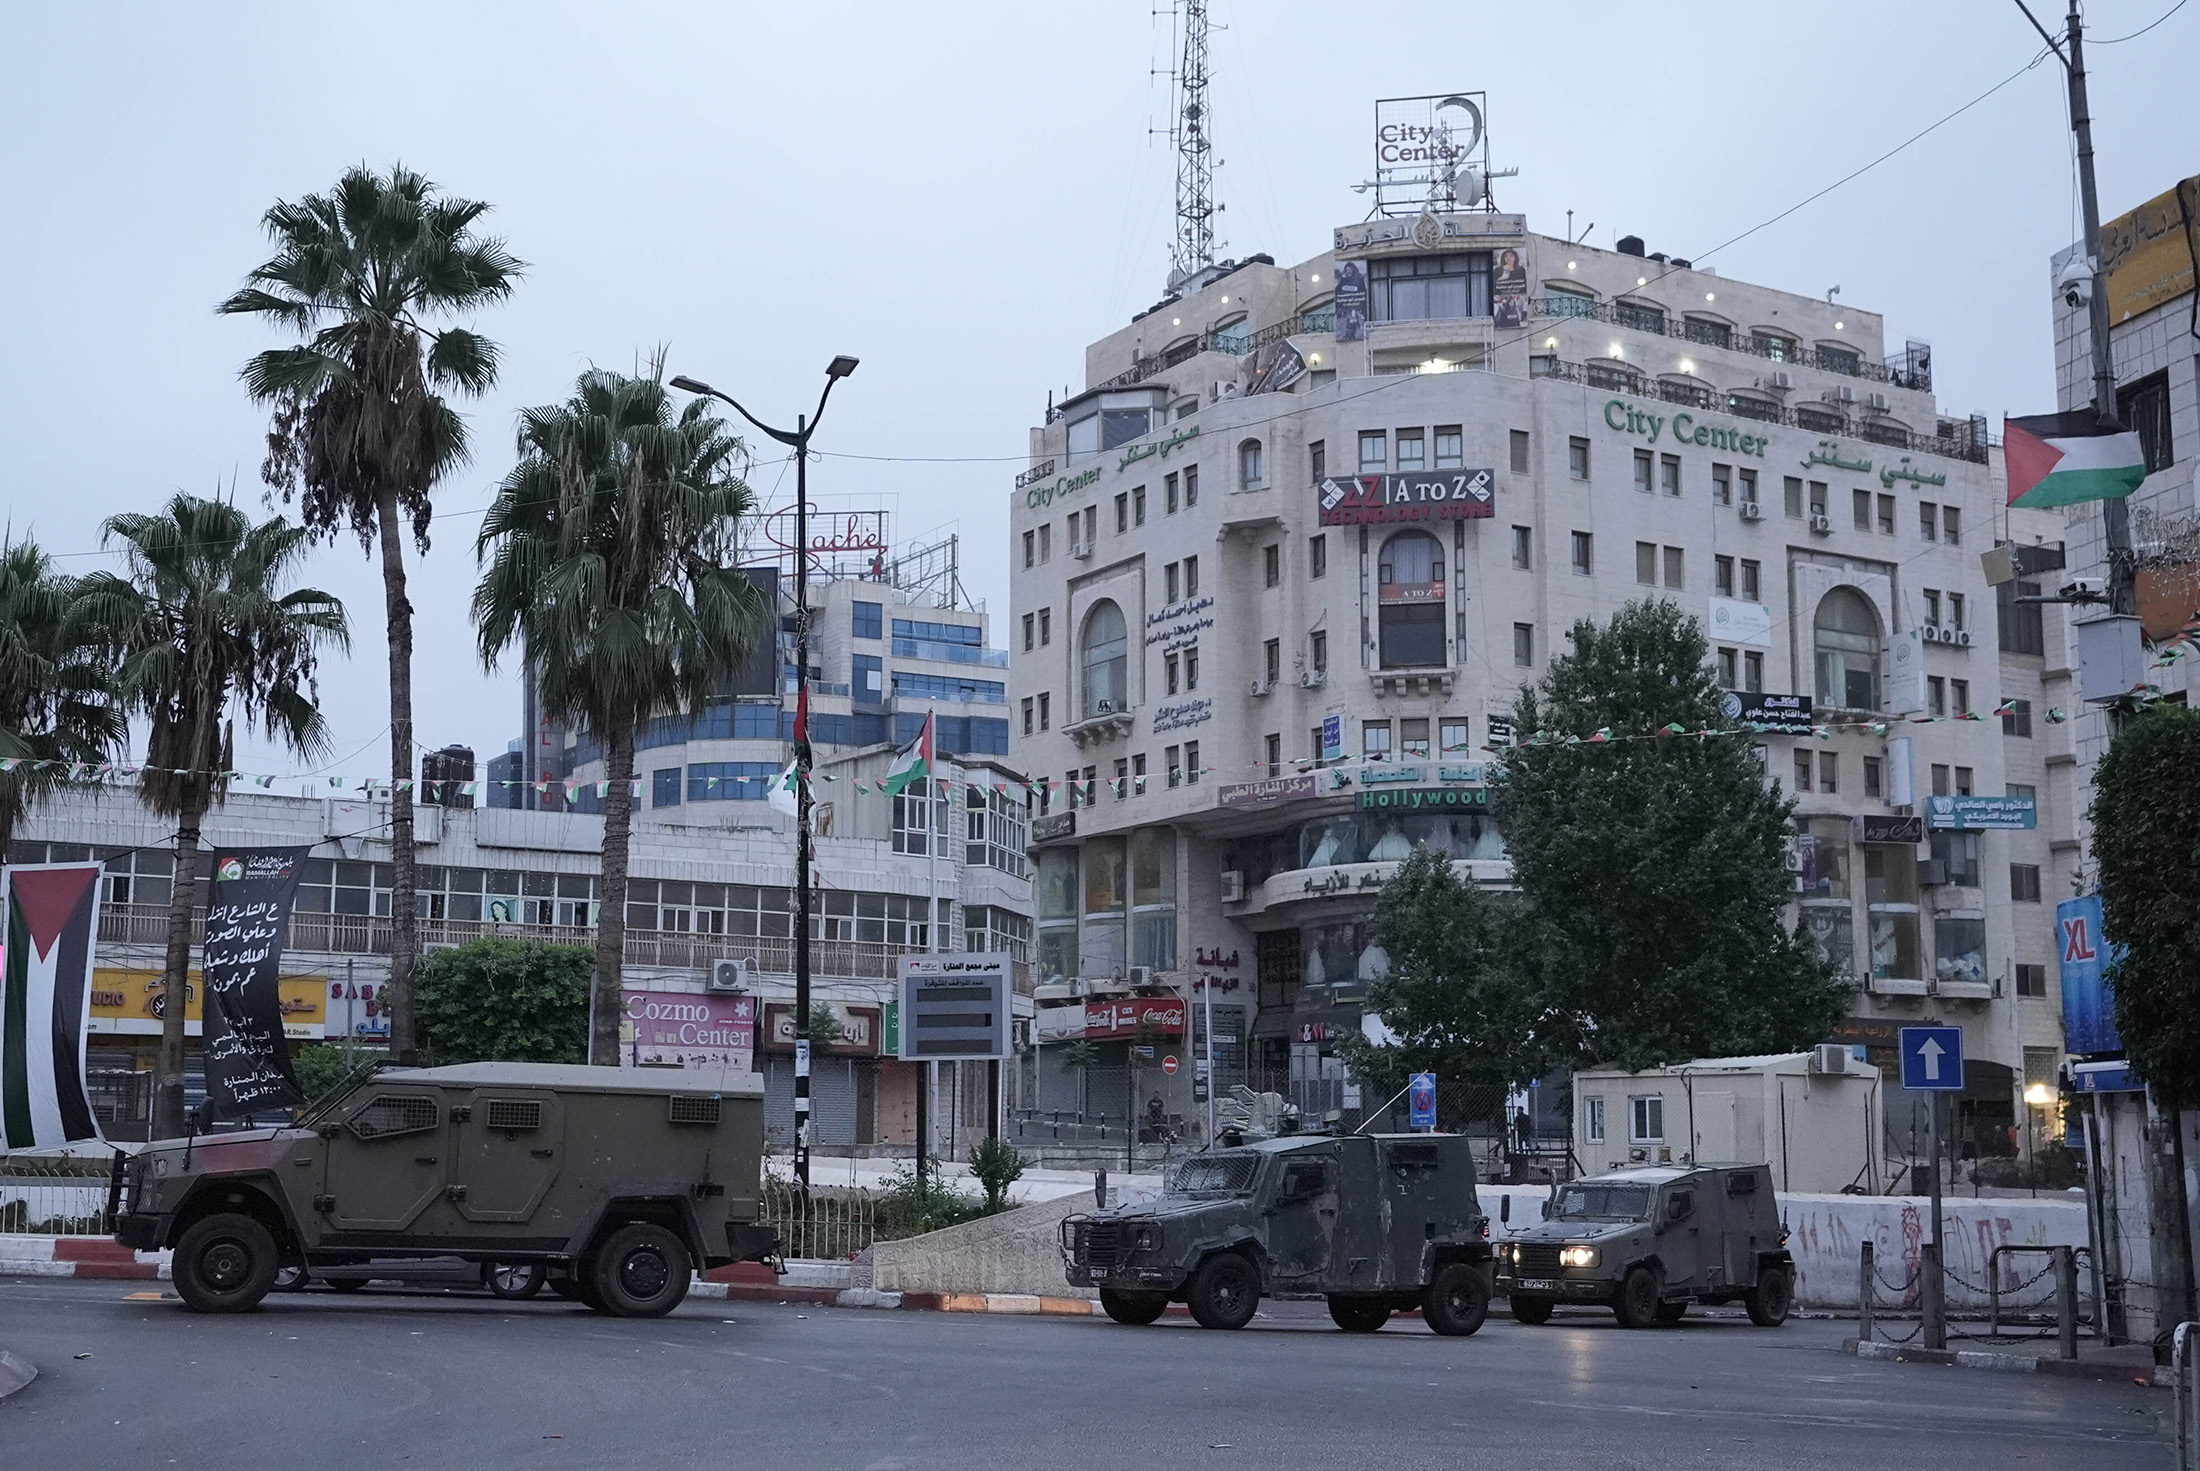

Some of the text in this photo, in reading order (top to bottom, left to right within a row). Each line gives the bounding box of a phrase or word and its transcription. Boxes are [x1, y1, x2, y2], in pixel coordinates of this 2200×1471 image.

[1380, 123, 1434, 145] City
[1380, 143, 1465, 163] Center
[1335, 219, 1524, 251] قناة الجزيرة
[1604, 399, 1768, 457] City Center
[1116, 425, 1200, 473] سيتي سنتر
[1800, 440, 1947, 489] سيتي سنتر
[1026, 466, 1103, 510] City Center
[1395, 479, 1411, 503] A
[1415, 483, 1447, 501] TO
[1451, 475, 1468, 500] Z
[1322, 503, 1492, 526] TECHNOLOGY STORE
[1762, 709, 1780, 719] حسن
[1780, 709, 1801, 720] الفتاح
[1221, 784, 1253, 804] الطبي
[1254, 780, 1285, 797] المنارة
[1286, 778, 1313, 794] مركز
[1361, 788, 1488, 809] Hollywood
[2006, 800, 2034, 811] الدكتور
[2000, 812, 2023, 822] البورد
[226, 901, 266, 925] الشارع
[2063, 918, 2096, 962] XL
[943, 962, 964, 972] المنارة
[965, 962, 982, 972] مجمع
[983, 961, 1001, 971] مبنى
[626, 995, 710, 1022] Cozmo
[1142, 1007, 1184, 1026] Coca-Cola
[679, 1023, 749, 1046] Center
[223, 1071, 259, 1089] المنارة
[2084, 1073, 2095, 1089] XL
